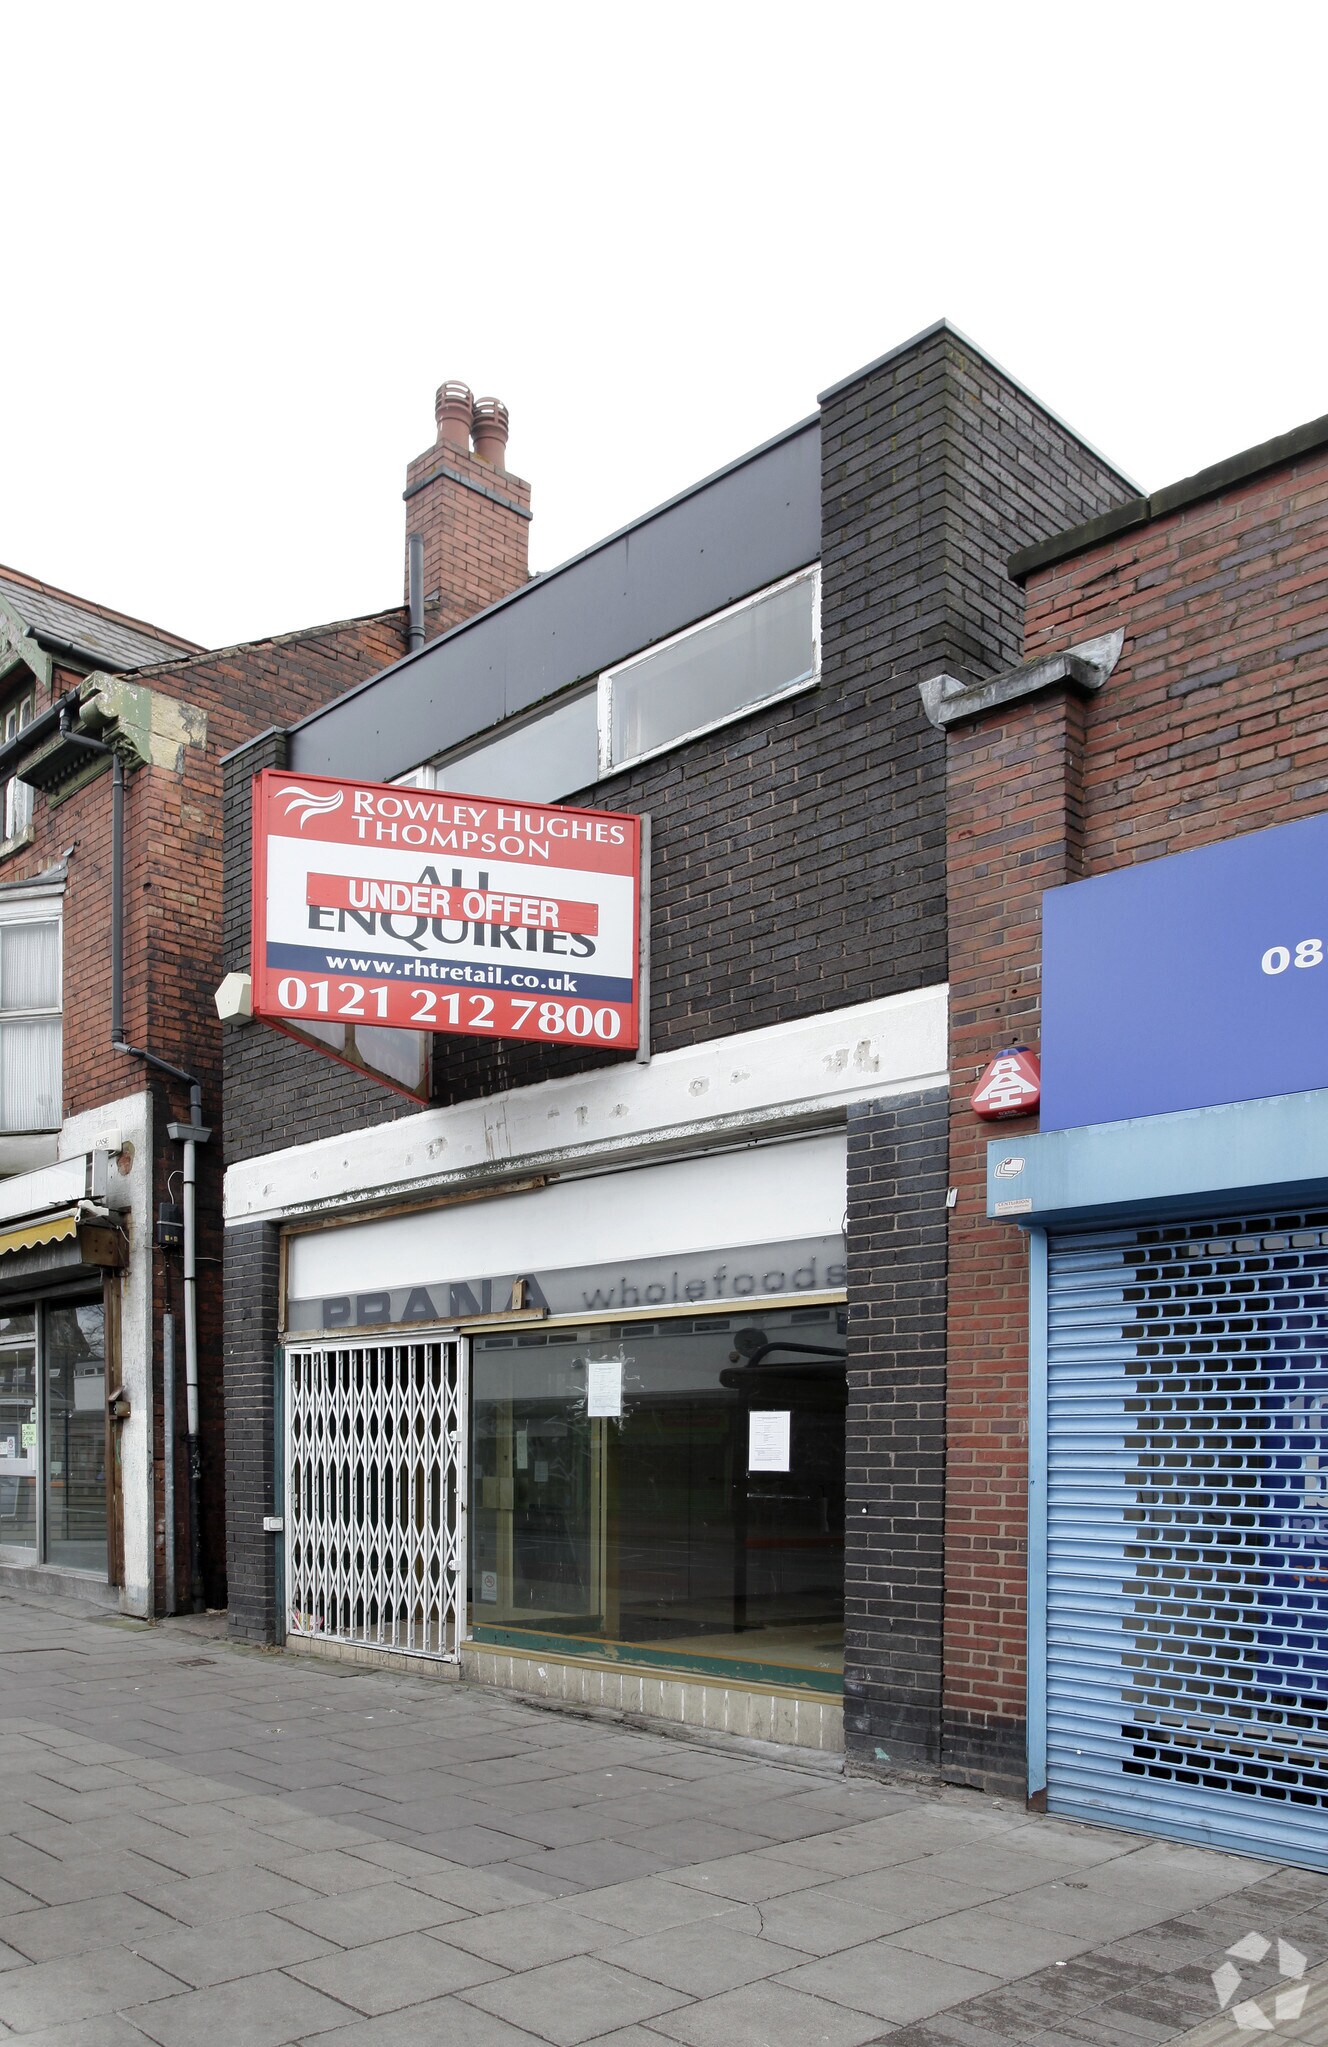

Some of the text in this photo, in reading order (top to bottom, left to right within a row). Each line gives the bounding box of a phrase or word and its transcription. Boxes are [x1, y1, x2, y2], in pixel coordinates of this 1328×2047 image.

[351, 815, 549, 860] THOMPSON
[354, 790, 625, 845] ROWLEY HUGHES
[348, 879, 559, 928] UNDER OFFER
[325, 955, 578, 993] www.rhtretail.co.uk
[277, 976, 622, 1040] 0121 212 7800
[322, 1255, 848, 1329] PRANA wholefoods
